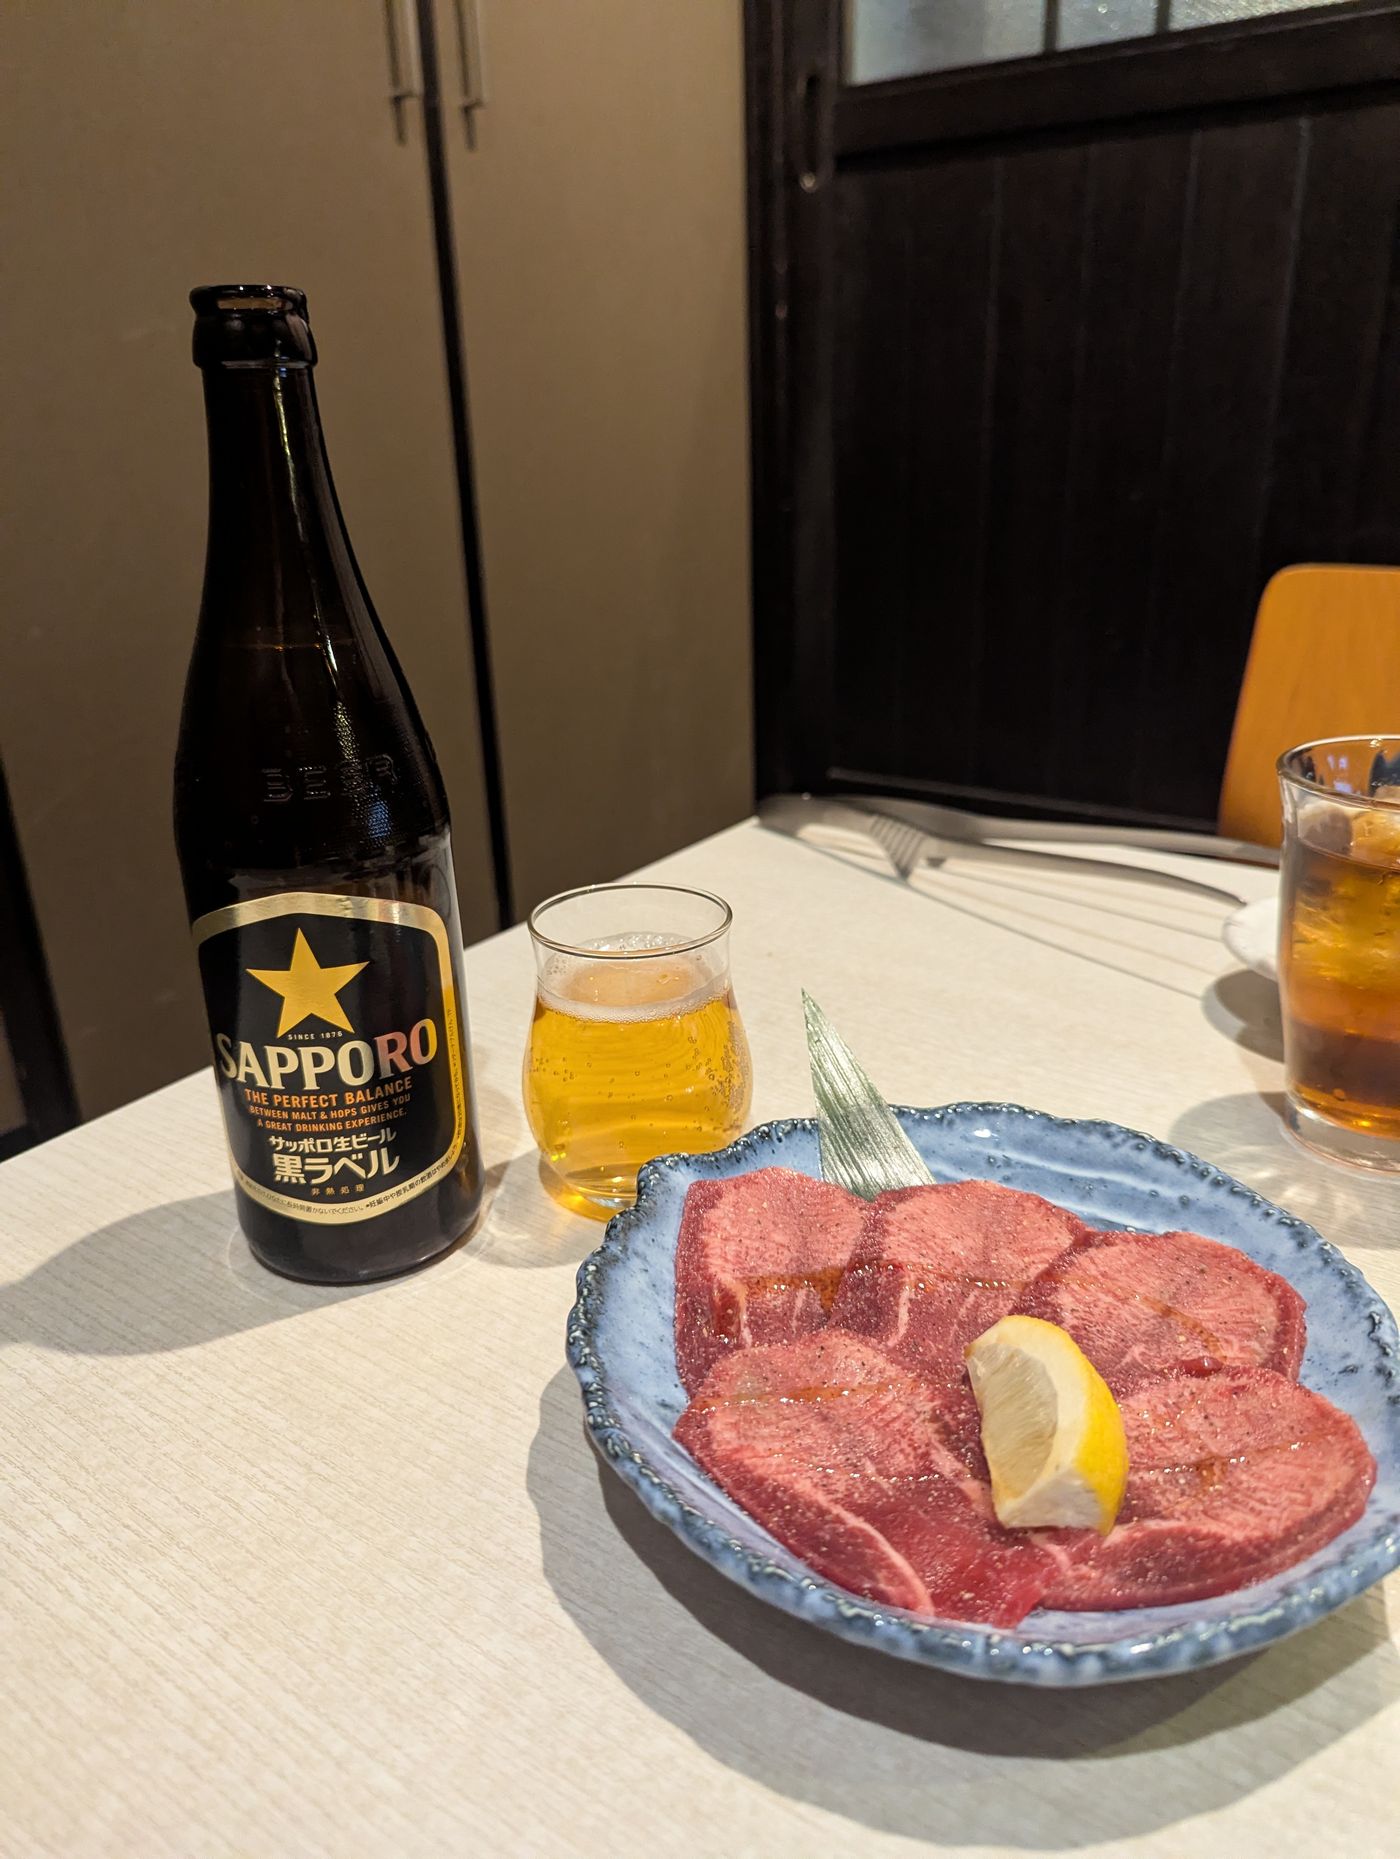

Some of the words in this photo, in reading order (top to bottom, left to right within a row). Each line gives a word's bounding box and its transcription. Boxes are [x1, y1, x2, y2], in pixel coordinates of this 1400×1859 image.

[321, 1030, 343, 1039] 1876
[216, 1018, 438, 1091] SAPPORO
[244, 1088, 269, 1105] THE
[273, 1094, 338, 1108] PERFECT
[344, 1076, 413, 1105] BALANCE
[249, 1105, 288, 1119] BETWEEN
[291, 1111, 317, 1120] MALT
[320, 1111, 328, 1119] &
[330, 1107, 357, 1118] HOPS
[360, 1100, 390, 1114] GIVES
[392, 1093, 411, 1106] YOU
[257, 1119, 263, 1127] A
[265, 1120, 292, 1131] GREAT
[295, 1122, 343, 1132] DRINKING
[269, 1127, 397, 1153] サッポロ生ビール
[273, 1147, 400, 1185] 黒ラベル
